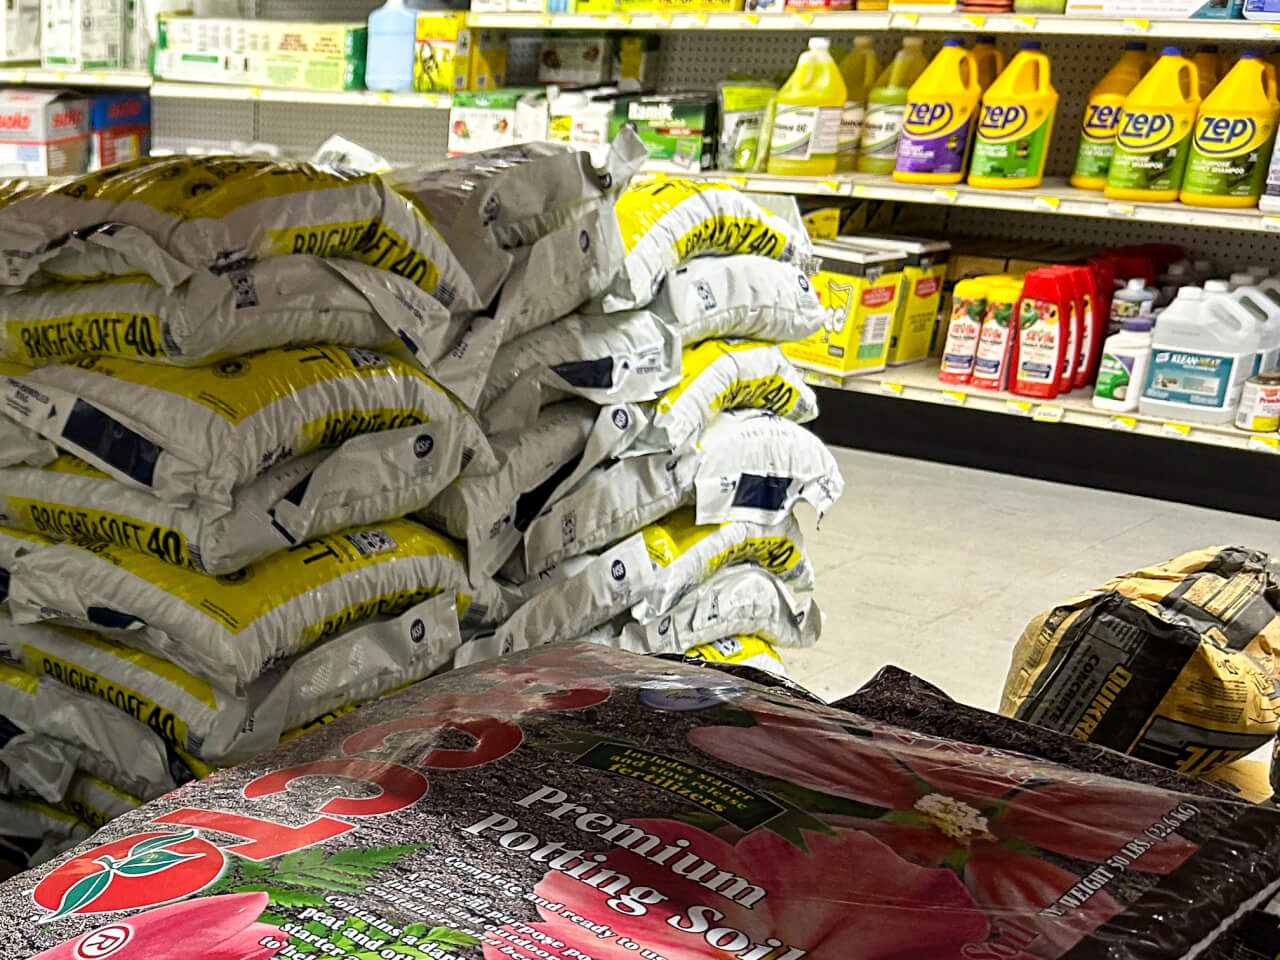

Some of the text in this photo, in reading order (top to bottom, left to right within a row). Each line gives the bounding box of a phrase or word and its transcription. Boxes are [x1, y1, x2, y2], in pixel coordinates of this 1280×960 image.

[146, 527, 184, 566] 40
[607, 763, 728, 813] fertilizers
[609, 754, 749, 810] and slow release
[623, 749, 755, 801] Includes starter
[460, 810, 670, 918] Potting
[513, 783, 771, 912] Premium
[1058, 865, 1117, 910] WEIGHT
[1106, 854, 1130, 872] 50
[1122, 838, 1156, 860] LBS.
[323, 894, 403, 940] Contains
[401, 932, 420, 946] a
[365, 886, 458, 931] containers
[383, 879, 448, 910] indoor
[445, 904, 486, 926] and
[444, 855, 522, 896] Complete
[524, 890, 562, 914] and
[562, 904, 618, 939] ready
[616, 935, 640, 952] to
[258, 936, 282, 950] to
[279, 921, 347, 958] starter
[297, 905, 344, 933] peat
[341, 926, 385, 953] and
